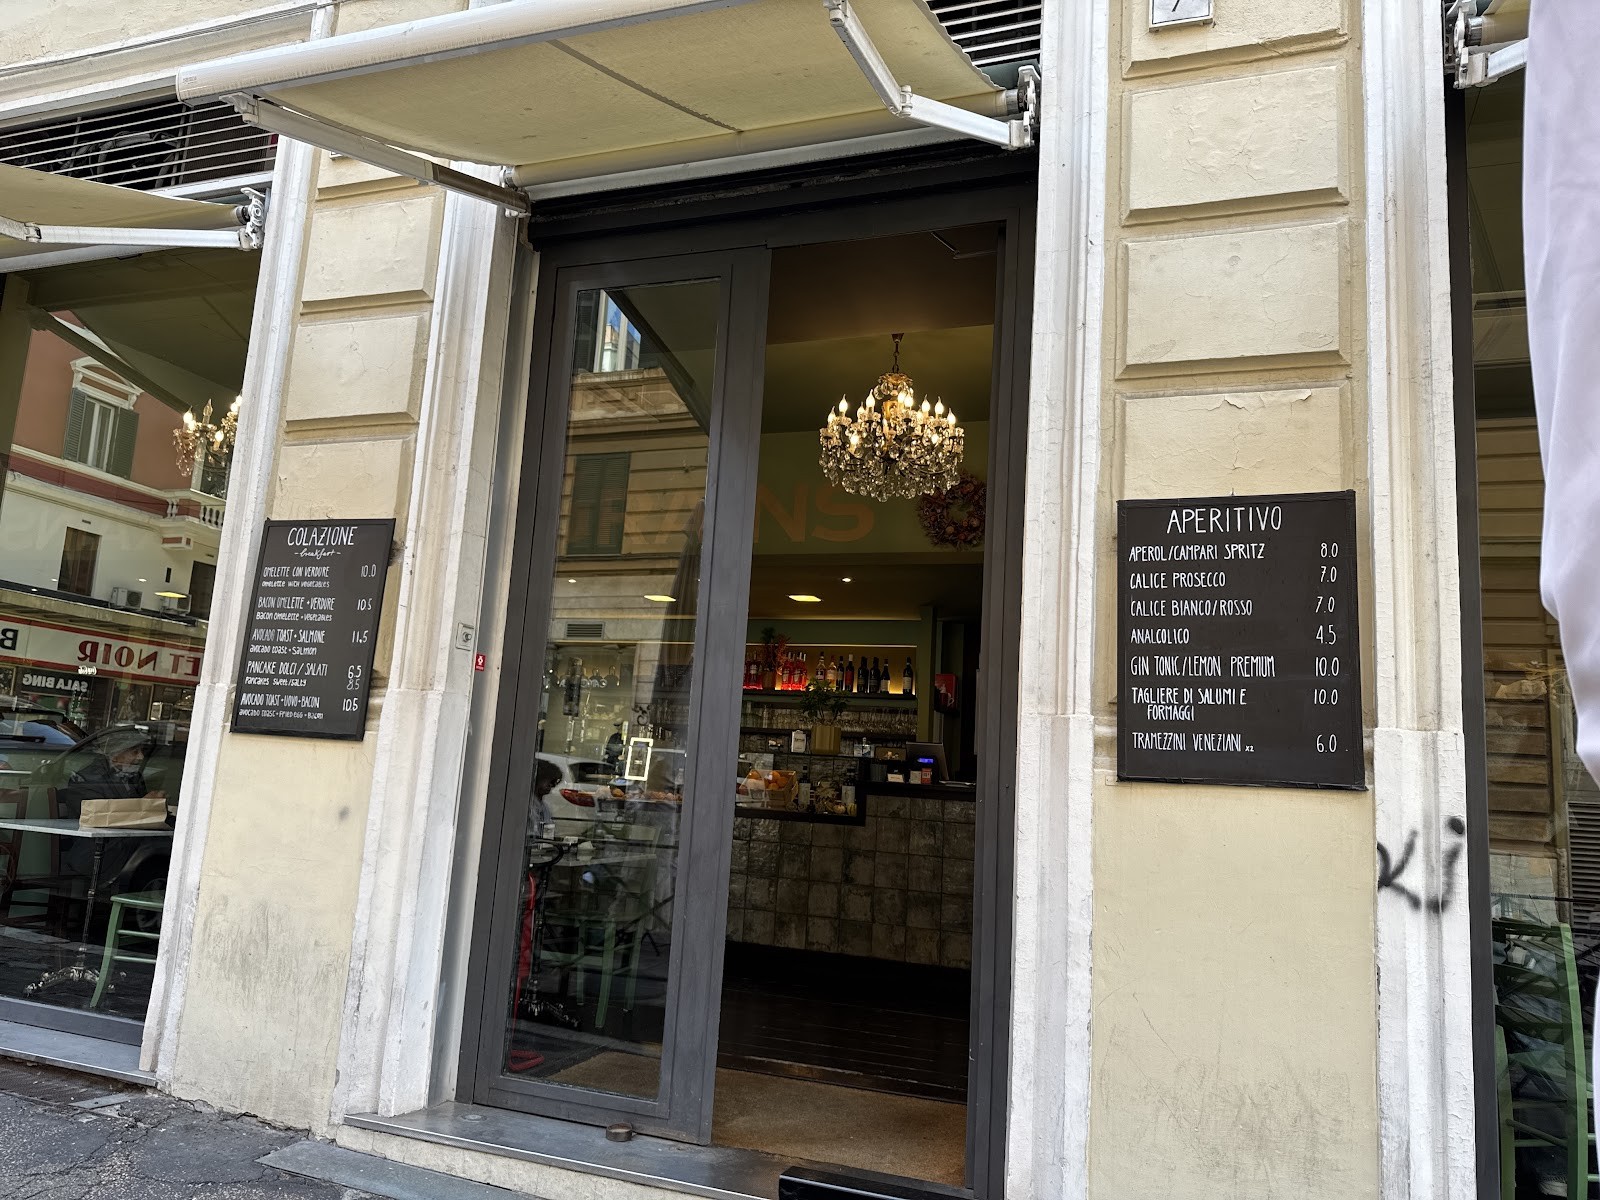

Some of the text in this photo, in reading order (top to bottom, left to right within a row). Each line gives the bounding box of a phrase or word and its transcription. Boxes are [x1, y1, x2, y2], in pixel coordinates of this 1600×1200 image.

[1166, 506, 1282, 534] APERITIVO
[288, 527, 357, 545] COLAZIONE
[1129, 542, 1338, 562] APEROL/CAMPARI SPRITZ 8.0
[263, 564, 376, 577] OMELETTE CON VERDURE 10.0
[1130, 566, 1337, 589] CALICE PROSECCO 7.0
[258, 597, 275, 608] BACON
[276, 597, 304, 609] OMELETTE
[1131, 596, 1335, 616] CALICE BIANCO/ROSSO 7.0
[252, 629, 275, 641] AVOCADO
[298, 630, 325, 643] SALMONE
[352, 631, 369, 643] 11.5
[1130, 624, 1336, 644] ANALCOLICO 4.5
[246, 661, 276, 674] PANCAKE
[348, 666, 361, 678] 6.5
[1131, 656, 1340, 678] GIN TONIC/LEMON PREMIUM 10.0
[347, 678, 360, 690] 8.5
[241, 693, 264, 706] AVOCADO
[1132, 687, 1338, 705] TAGLIERE DI SALUMI E 10.0
[1147, 705, 1194, 721] FORMAGGI
[1132, 732, 1186, 751] TRAMEZZINI
[1192, 733, 1241, 752] VENEZIANI
[1316, 734, 1336, 753] 6.0
